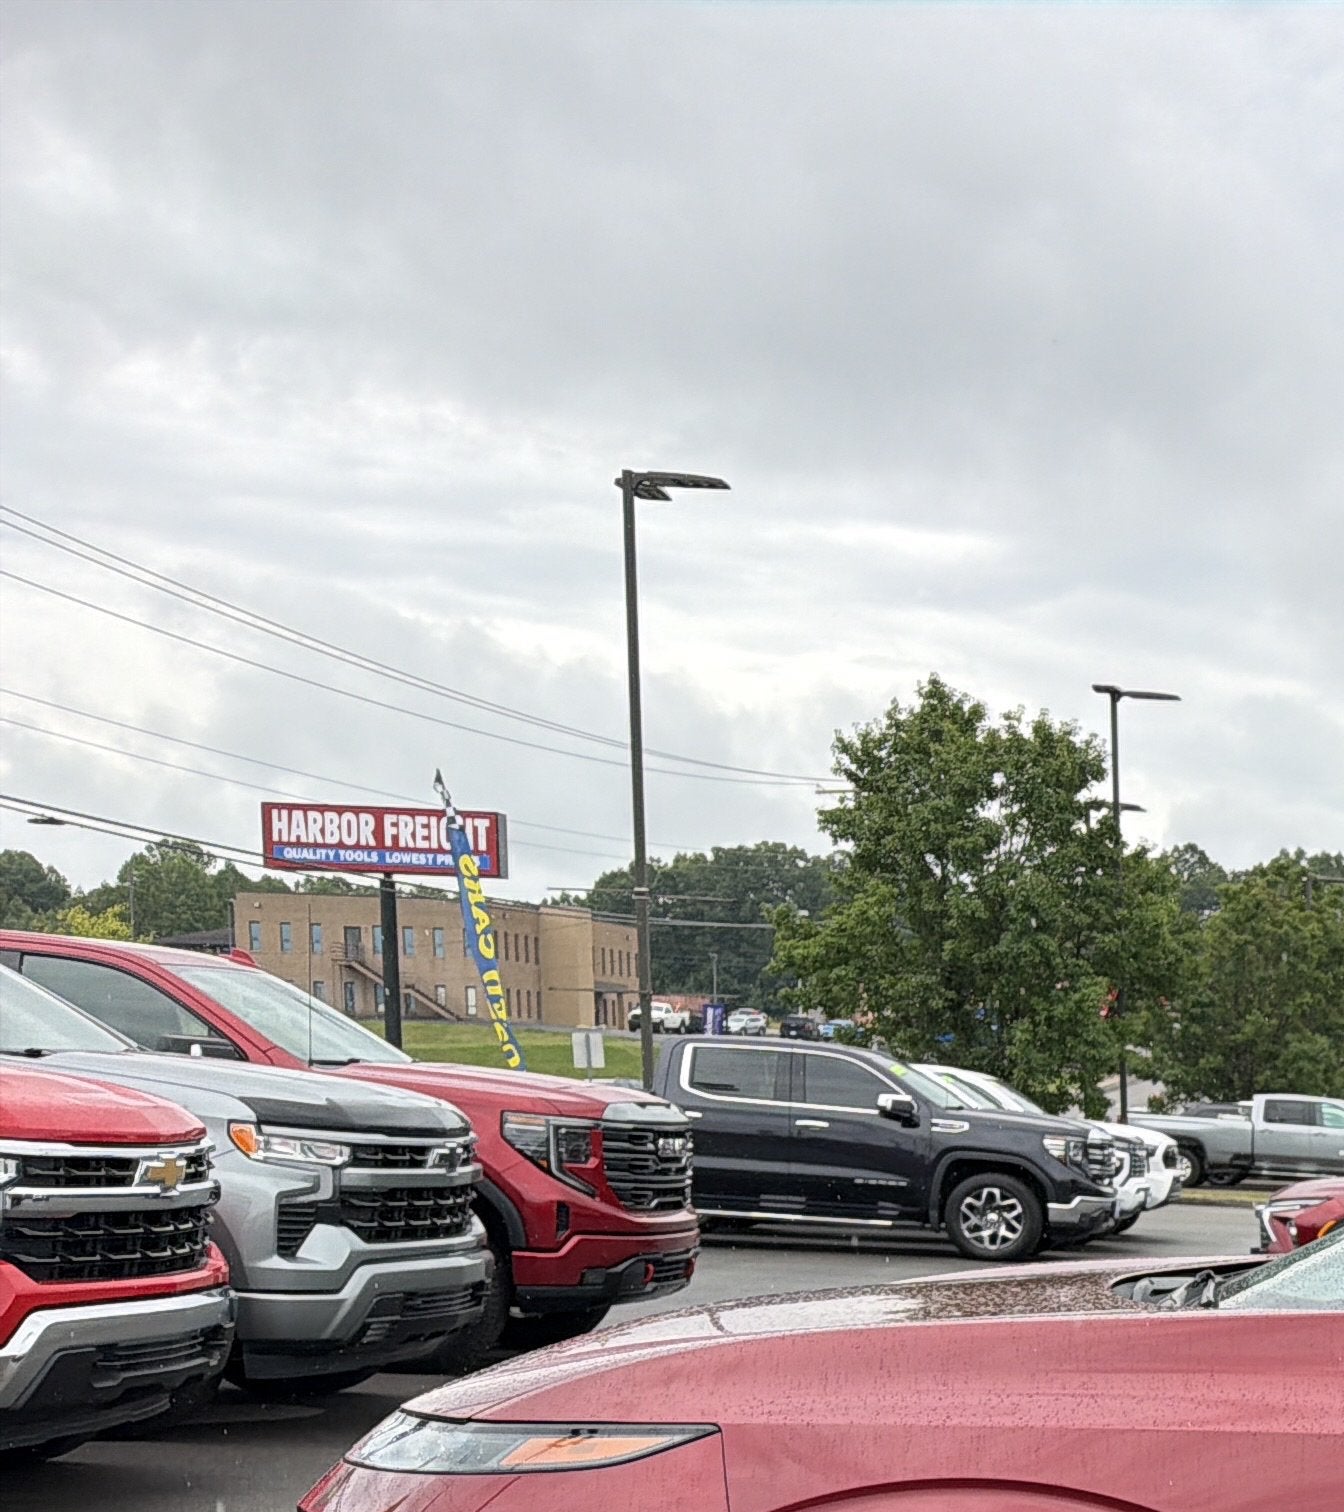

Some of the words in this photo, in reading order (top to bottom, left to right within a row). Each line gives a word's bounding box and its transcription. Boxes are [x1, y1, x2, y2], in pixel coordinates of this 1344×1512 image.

[271, 808, 376, 847] HARBOR
[284, 846, 335, 862] QUALITY
[340, 849, 379, 863] TOOLS
[385, 851, 434, 866] LOWEST
